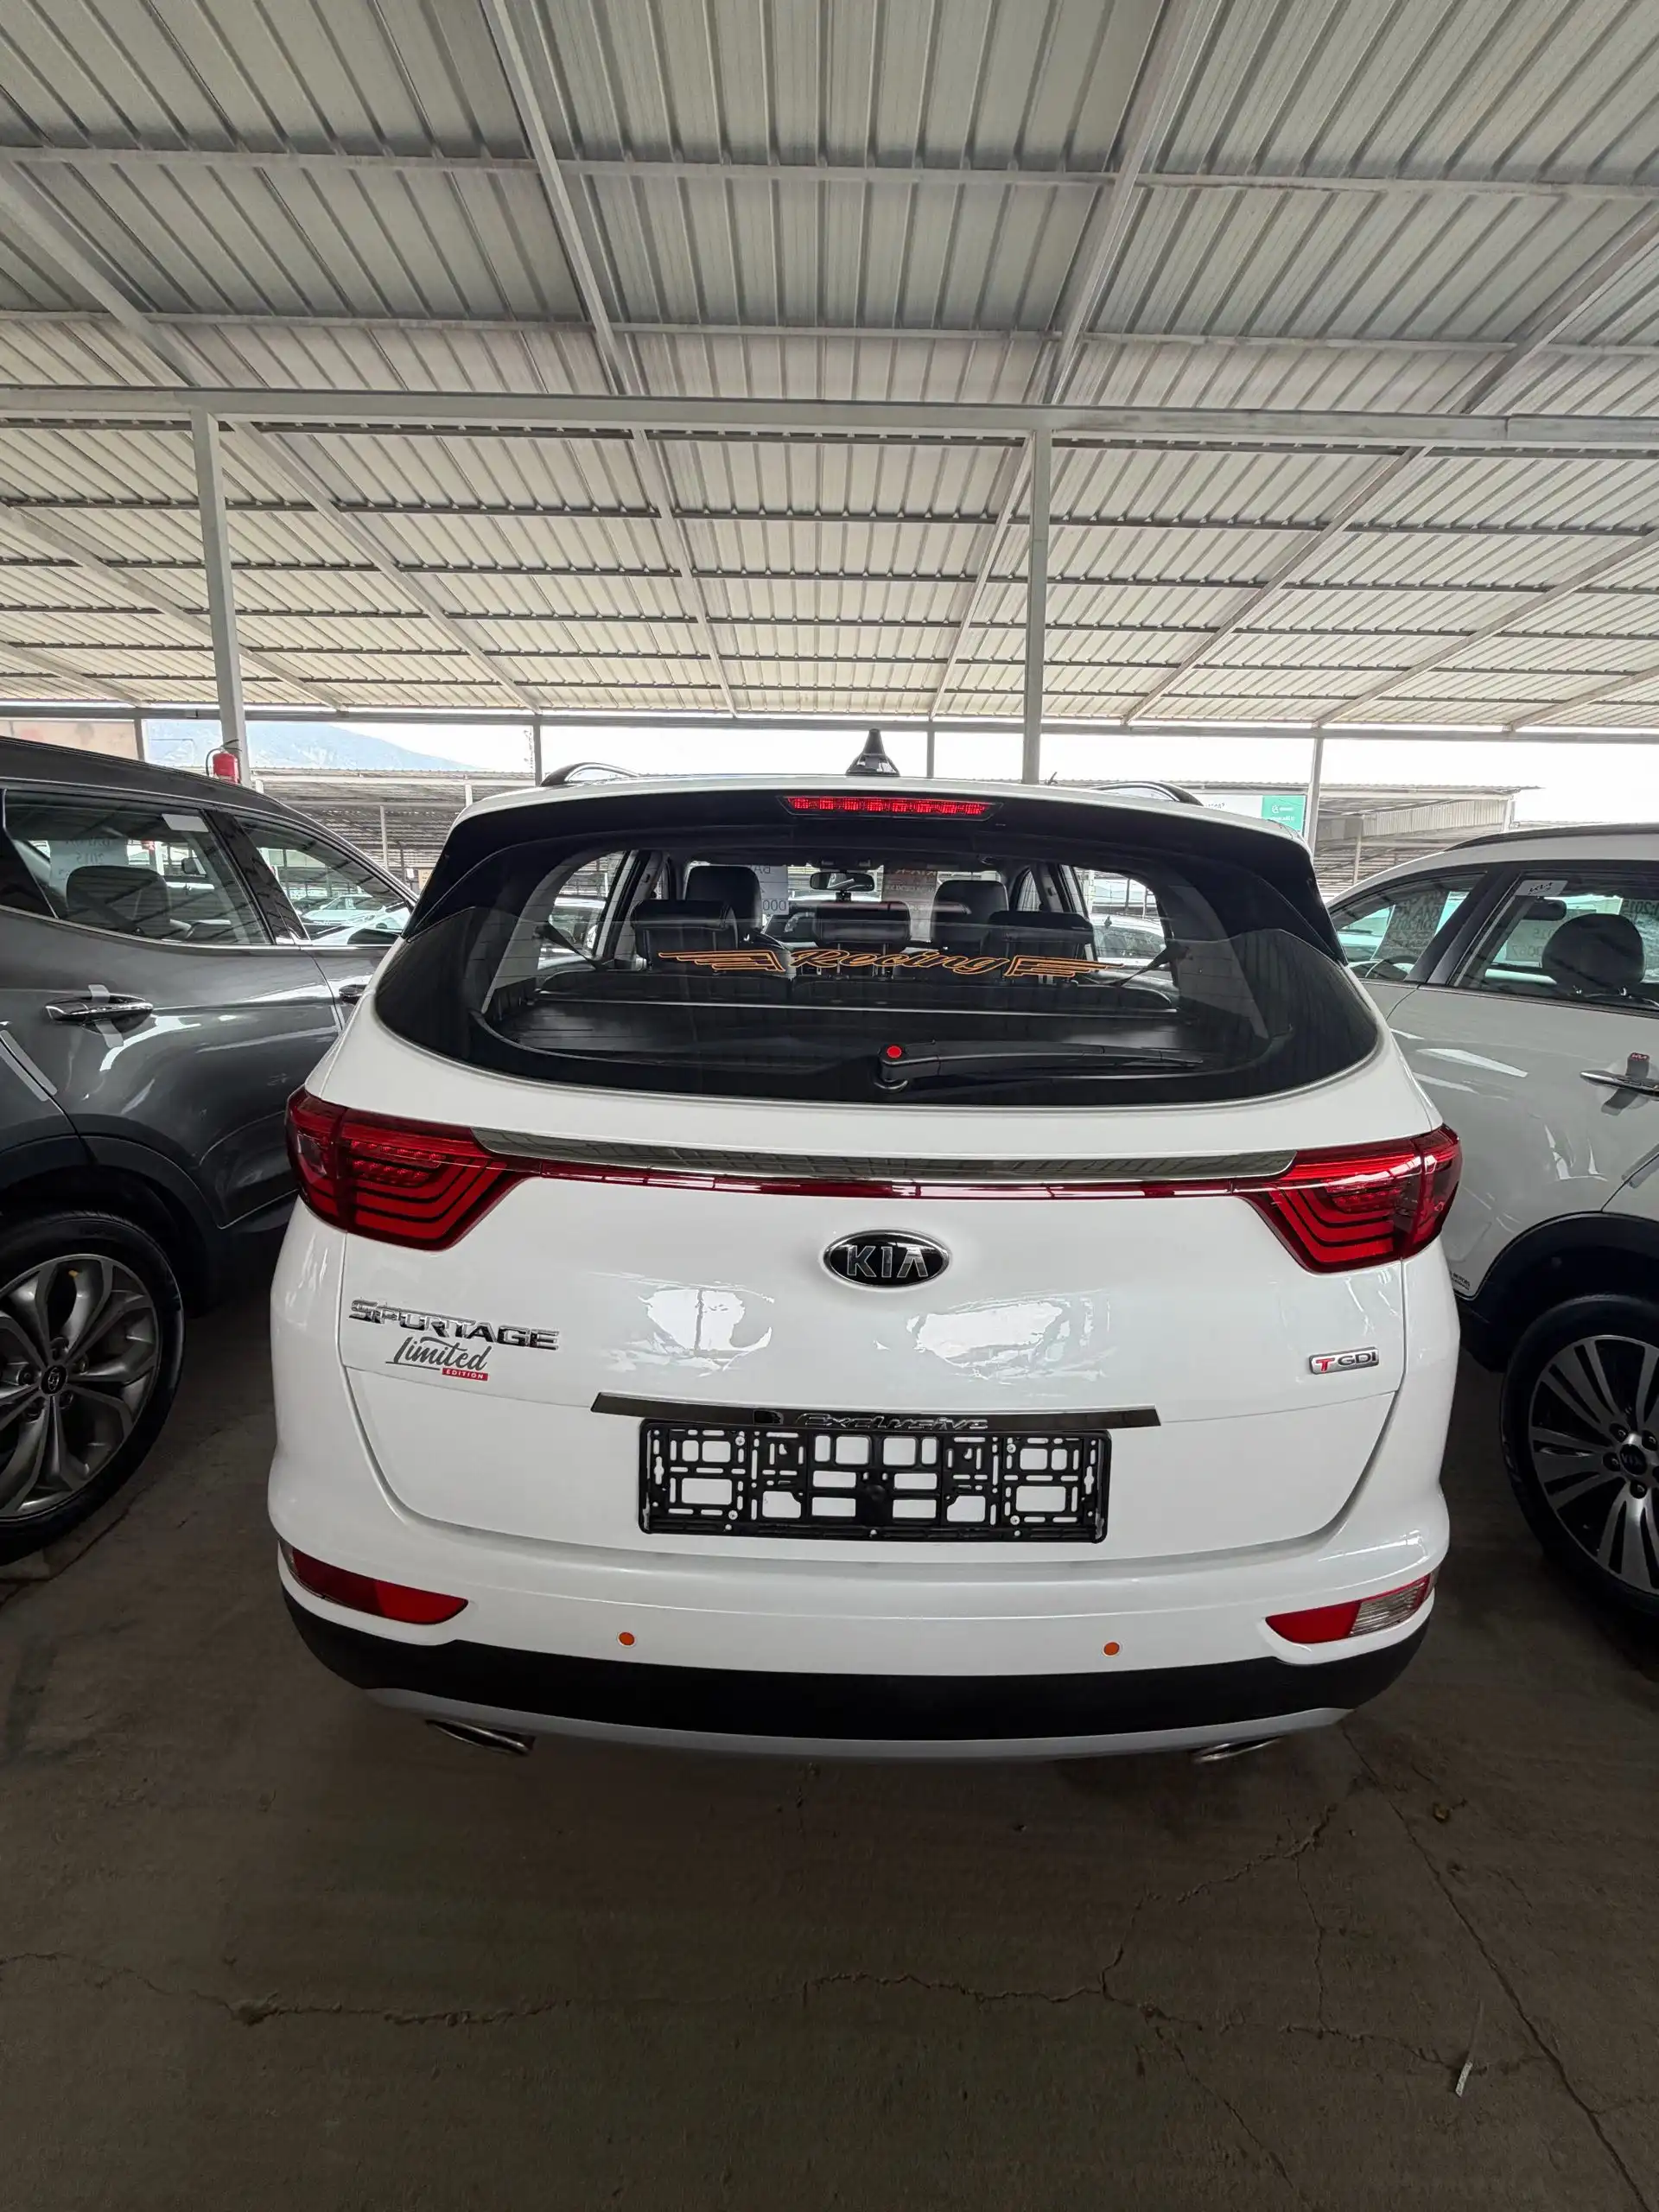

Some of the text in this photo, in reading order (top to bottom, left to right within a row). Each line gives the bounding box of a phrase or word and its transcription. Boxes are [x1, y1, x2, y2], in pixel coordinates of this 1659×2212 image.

[847, 1245, 929, 1278] KIA
[349, 1299, 560, 1351] SPORTAGE
[391, 1336, 493, 1371] Limited
[445, 1368, 486, 1381] EDITION
